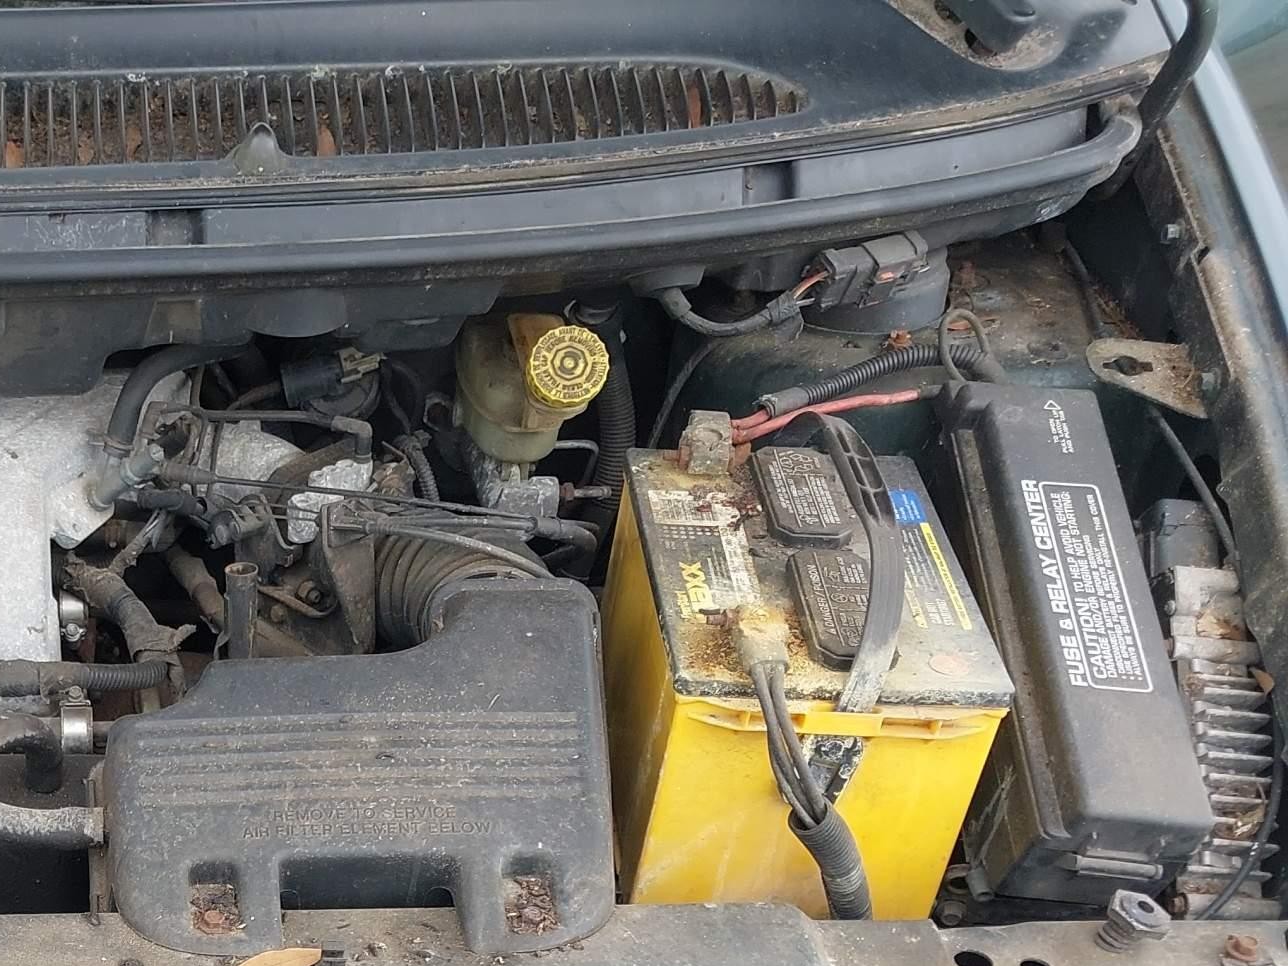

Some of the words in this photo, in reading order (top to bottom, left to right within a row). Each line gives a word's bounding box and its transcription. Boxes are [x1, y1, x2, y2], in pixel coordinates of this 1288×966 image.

[1022, 480, 1052, 549] CENTER
[1050, 493, 1067, 526] VEHICLE
[1061, 492, 1079, 535] STARTING:
[1060, 529, 1075, 554] AVOID
[1072, 538, 1085, 557] NOT
[1067, 557, 1081, 579] HELP
[1078, 560, 1095, 593] ENGINE
[1040, 555, 1068, 613] RELAY
[1073, 581, 1085, 592] TO
[1059, 618, 1073, 630] &
[1088, 596, 1106, 634] AND/OR
[1100, 598, 1113, 628] BATTERY
[1075, 598, 1107, 678] CAUTION!
[1060, 636, 1088, 686] FUSE
[1098, 637, 1117, 678] DAMAGE
[1128, 647, 1142, 675] ALWAYS
[273, 807, 345, 822] REMOVE
[354, 806, 376, 820] TO
[381, 805, 456, 819] SERVICE
[243, 826, 269, 839] AIR
[276, 823, 333, 837] FILTER
[337, 821, 421, 836] ELEMENT
[429, 820, 491, 835] BELOW
